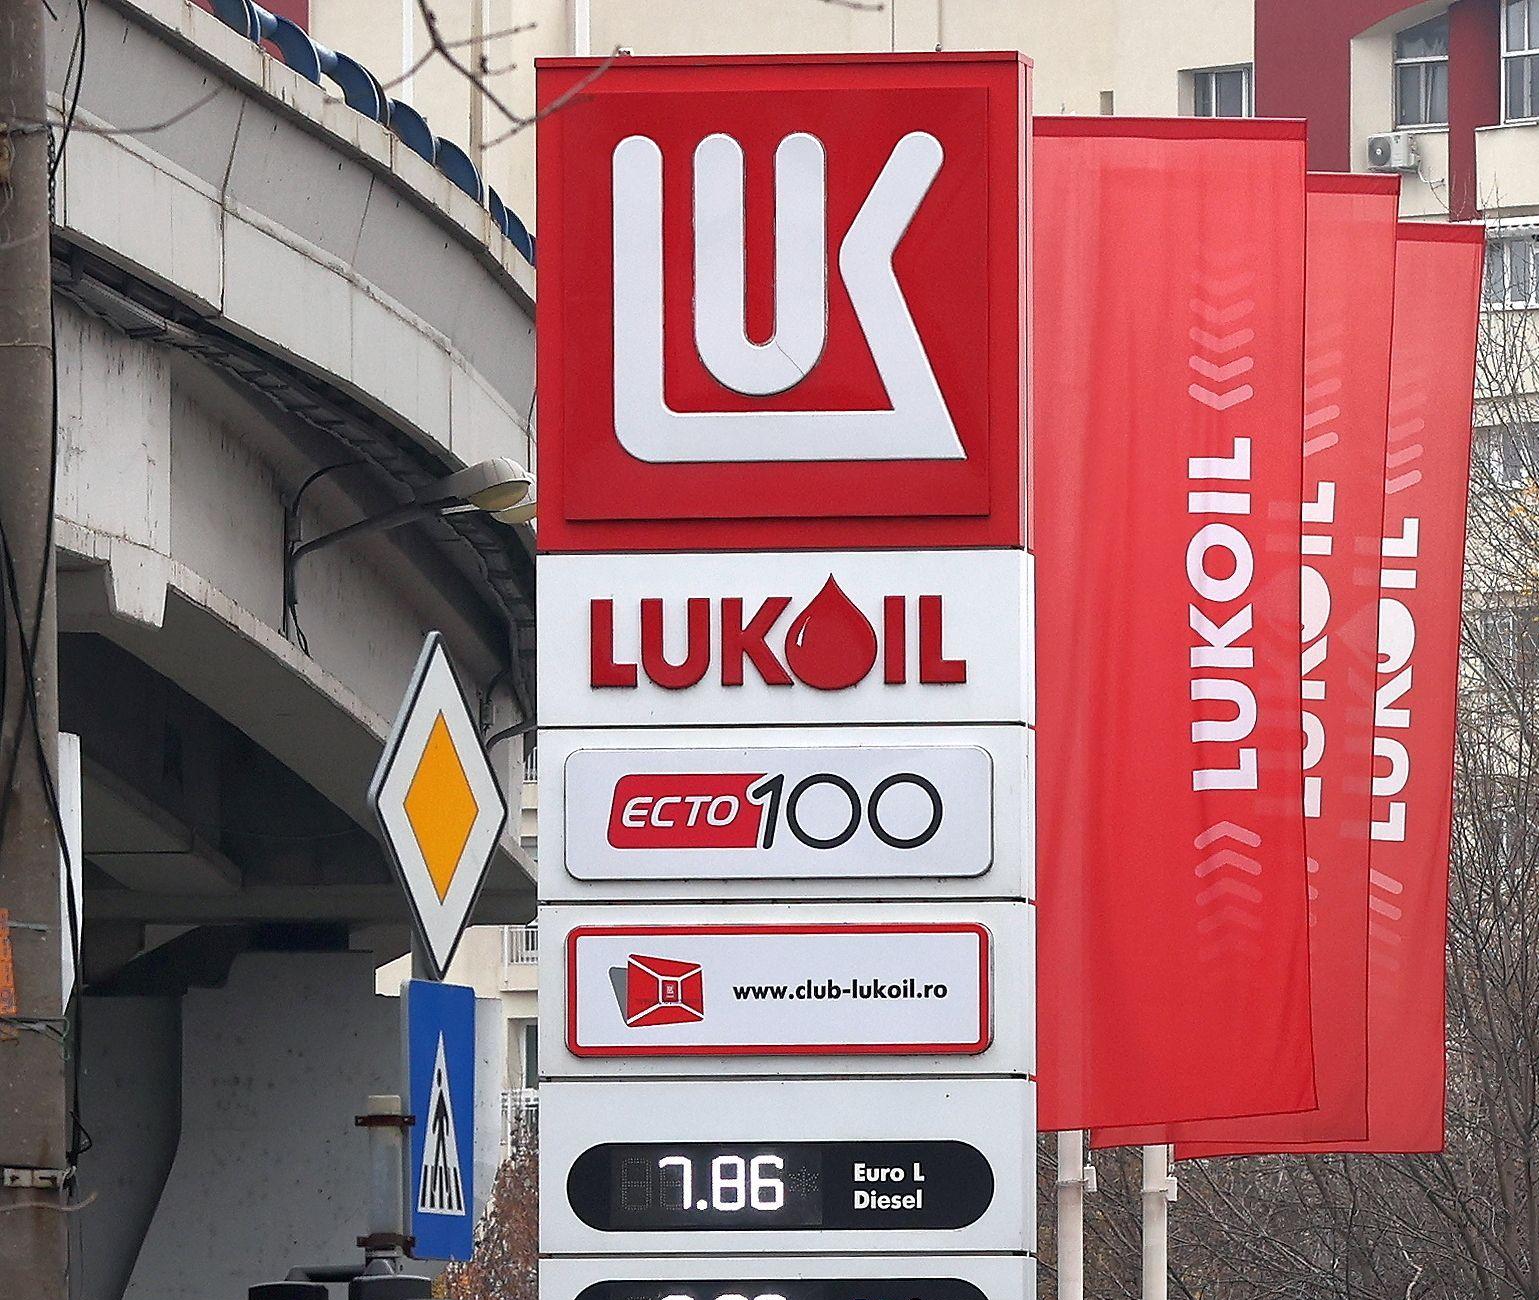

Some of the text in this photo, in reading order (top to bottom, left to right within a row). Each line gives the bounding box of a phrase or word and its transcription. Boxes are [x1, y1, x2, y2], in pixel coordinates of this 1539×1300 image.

[1187, 437, 1258, 792] LUKOIL
[590, 574, 966, 691] LUKOIL
[621, 796, 740, 828] ECTO
[733, 979, 948, 1000] www.club-lukoil.ro
[658, 1154, 785, 1212] 7.86
[854, 1163, 925, 1182] Euro L
[854, 1189, 923, 1209] Diesel
